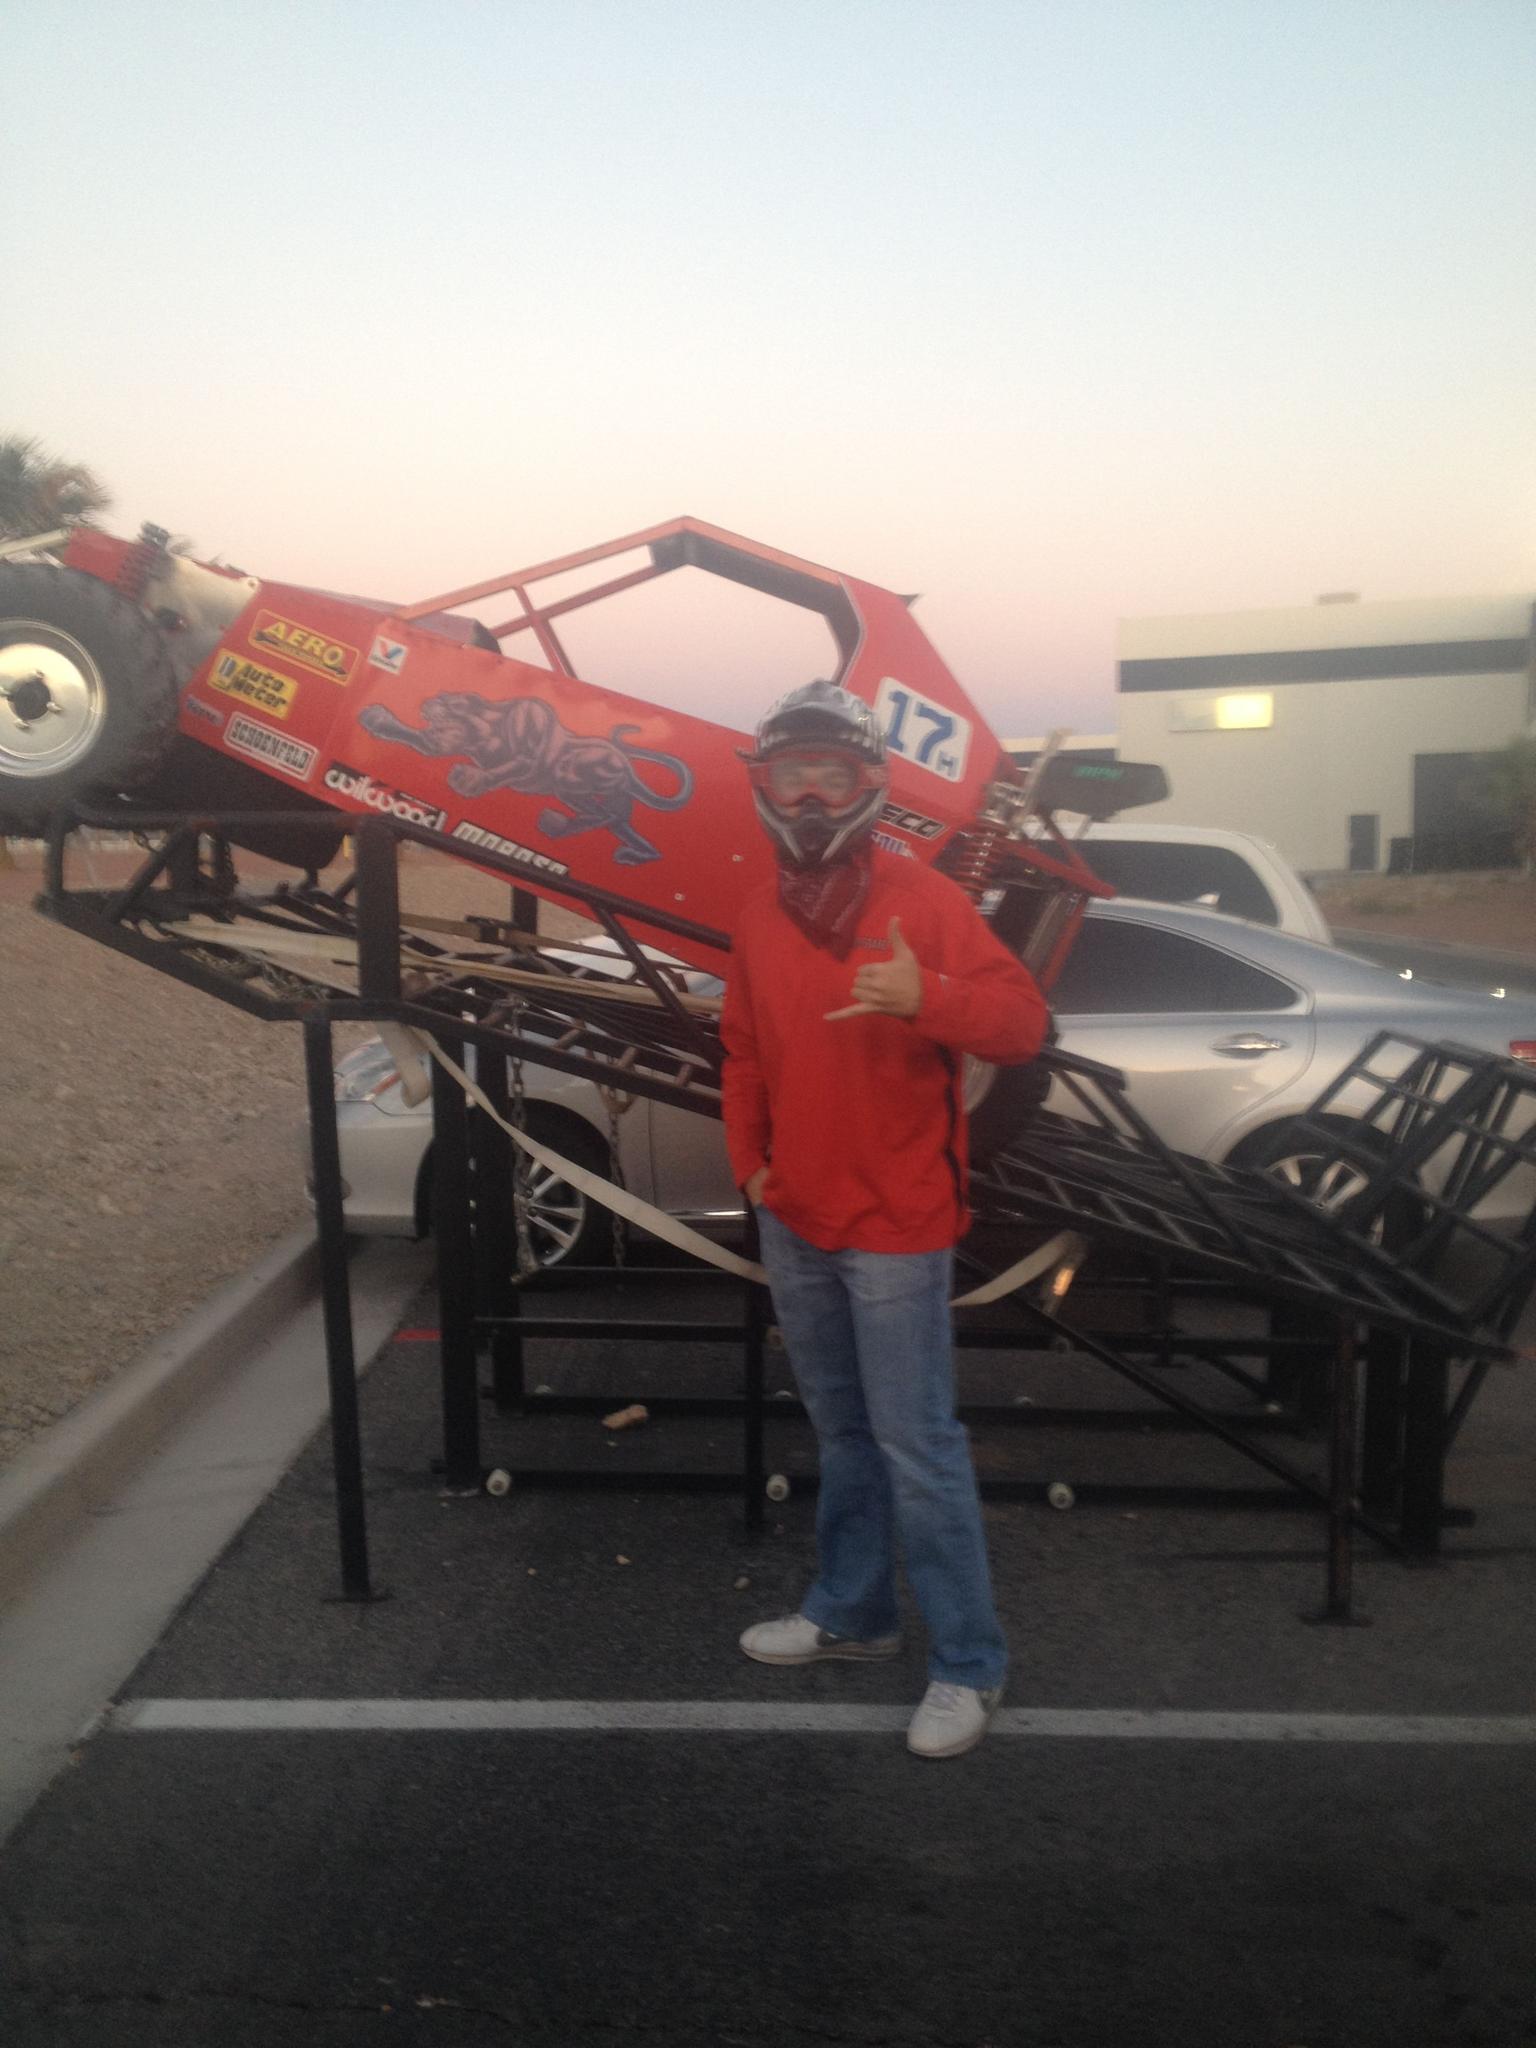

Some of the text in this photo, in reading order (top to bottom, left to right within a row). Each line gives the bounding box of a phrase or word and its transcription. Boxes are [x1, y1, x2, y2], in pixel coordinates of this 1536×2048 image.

[263, 621, 344, 666] AERO
[238, 664, 285, 692] Auto
[232, 720, 310, 770] SCHOENFELD
[325, 769, 447, 832] wilwood
